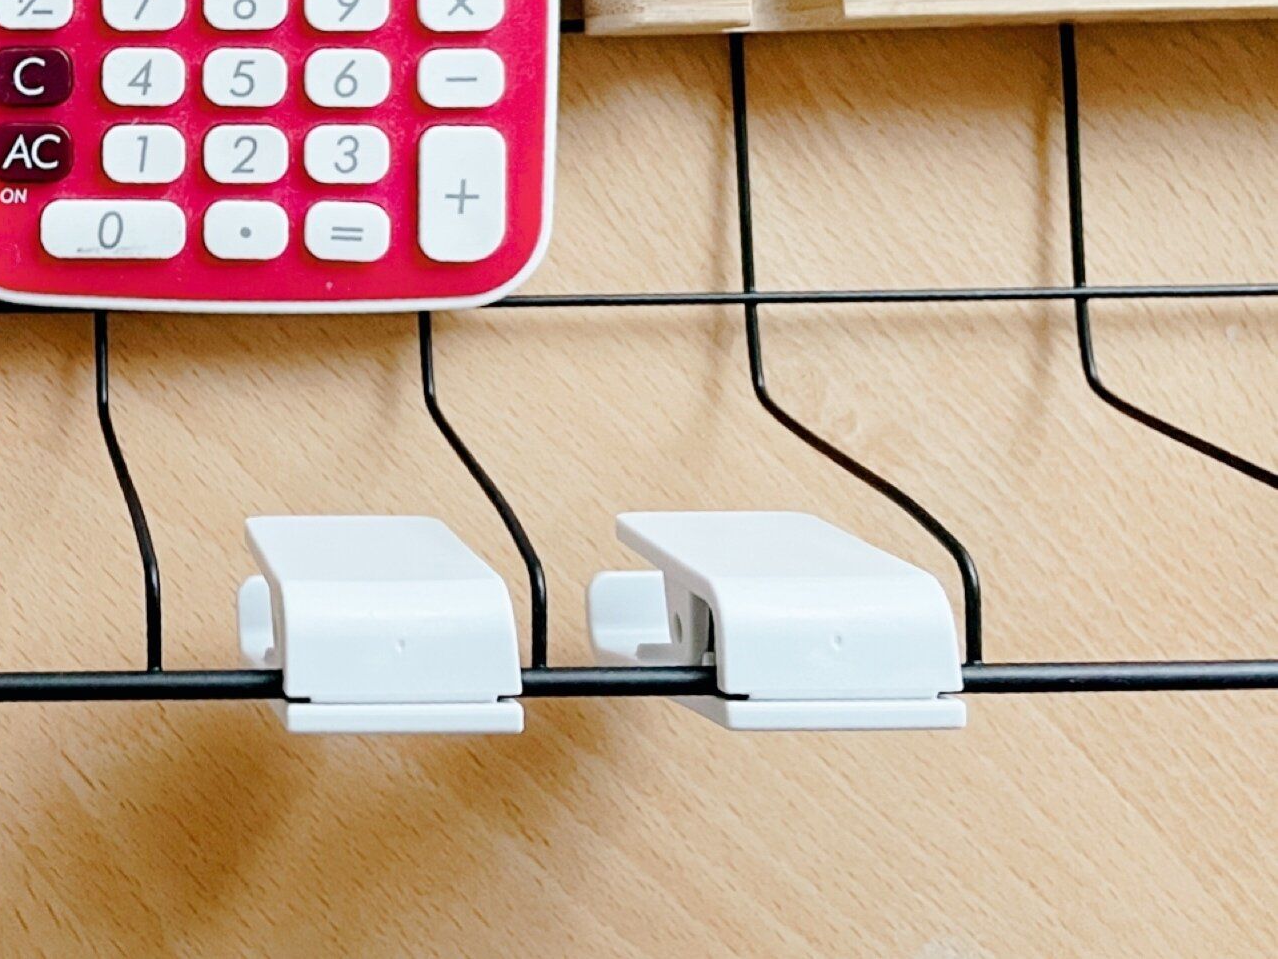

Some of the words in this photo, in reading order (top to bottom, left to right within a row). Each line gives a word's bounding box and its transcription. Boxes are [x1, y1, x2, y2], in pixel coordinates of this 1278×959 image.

[13, 56, 46, 96] C
[127, 58, 153, 96] 4
[229, 60, 256, 97] 5
[333, 59, 359, 98] 6
[2, 134, 61, 171] AC
[134, 135, 149, 173] 1
[231, 136, 259, 174] 2
[334, 135, 360, 174] 3
[0, 188, 28, 204] ON
[98, 210, 124, 249] 0
